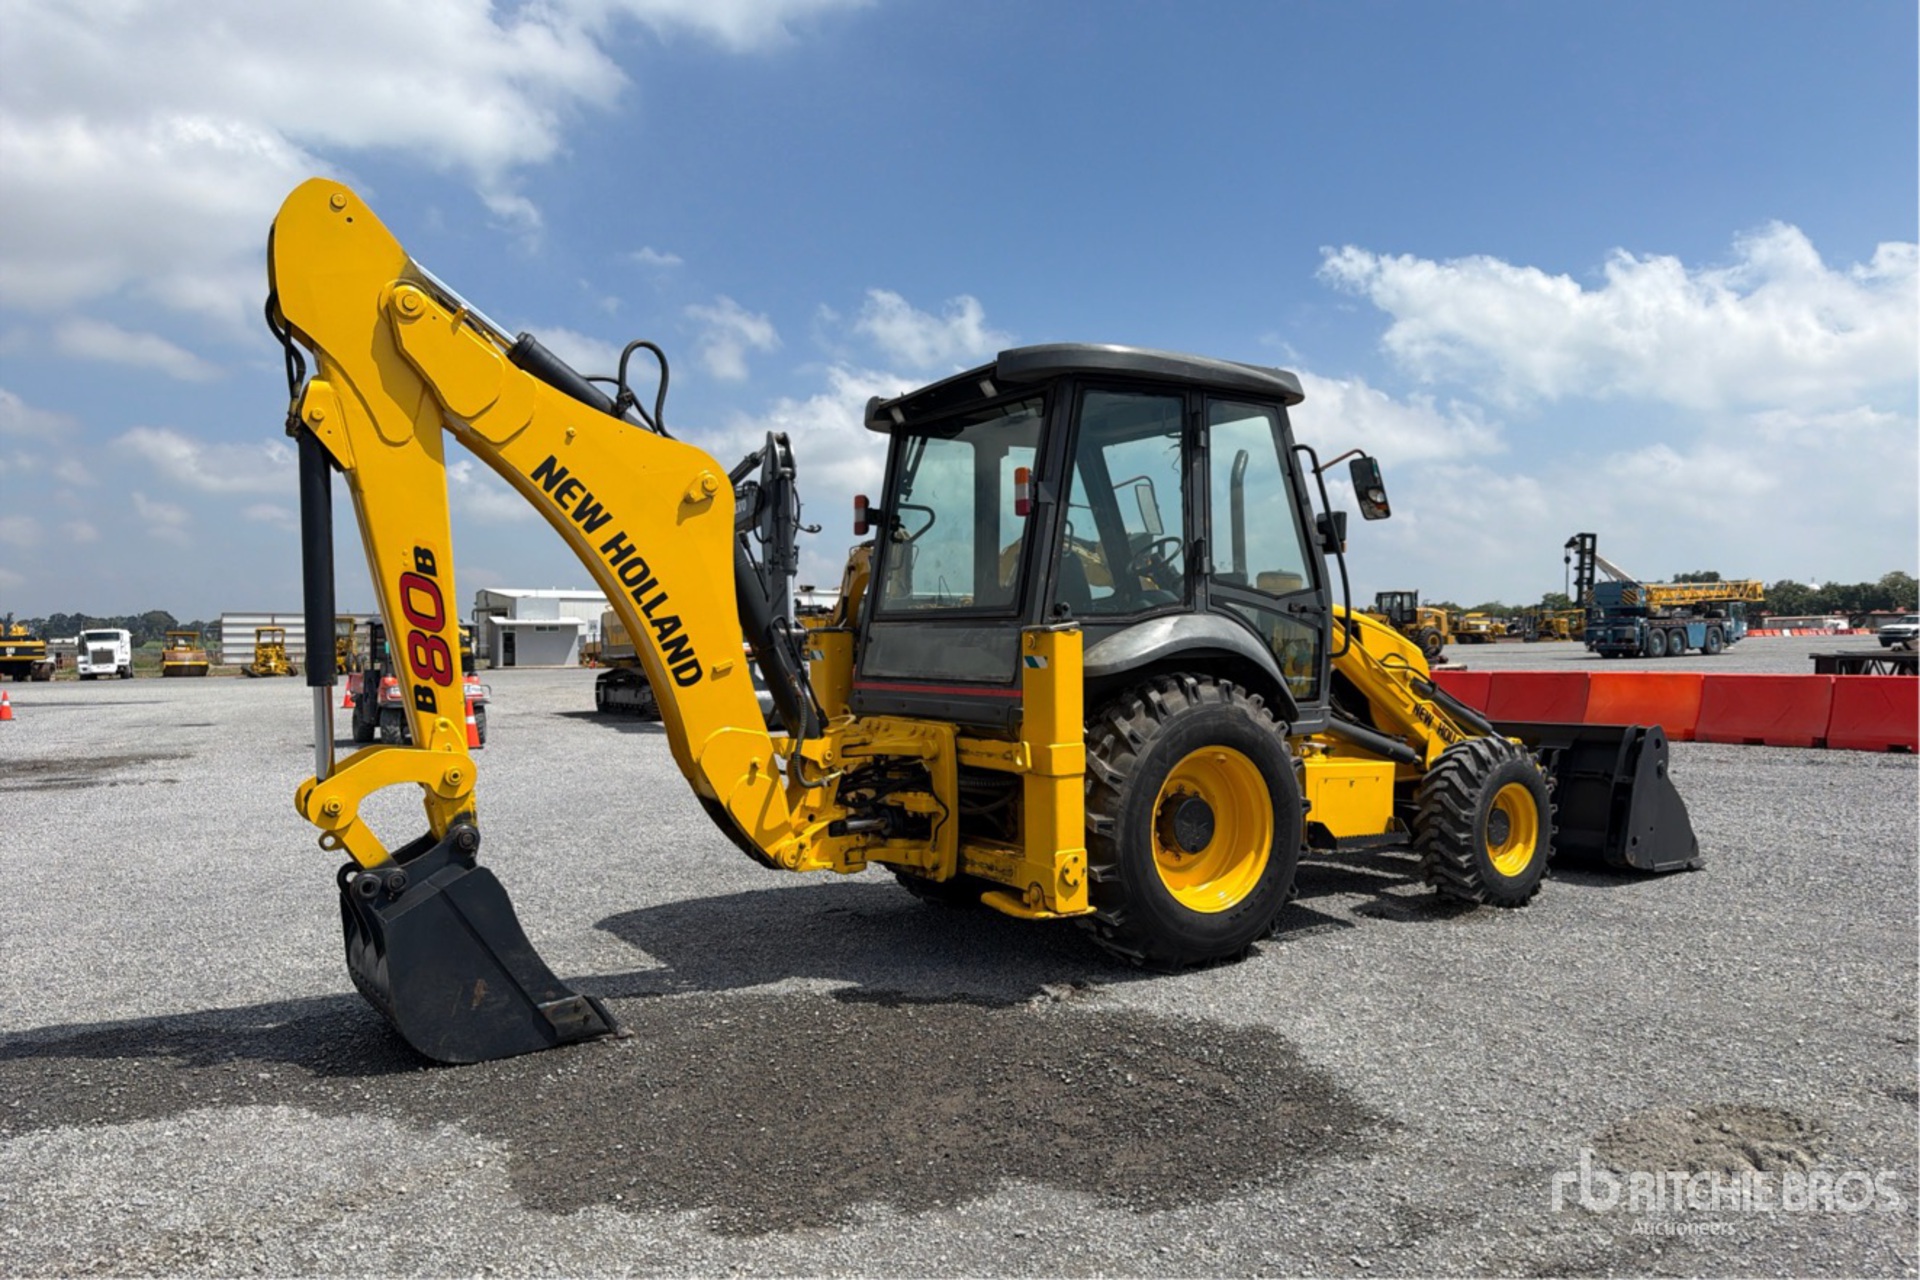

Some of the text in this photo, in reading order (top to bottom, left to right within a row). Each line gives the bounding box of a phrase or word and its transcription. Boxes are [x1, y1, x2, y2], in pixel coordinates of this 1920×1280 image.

[530, 455, 703, 687] NEW HOLLAND
[1414, 703, 1462, 744] NEW HOLL
